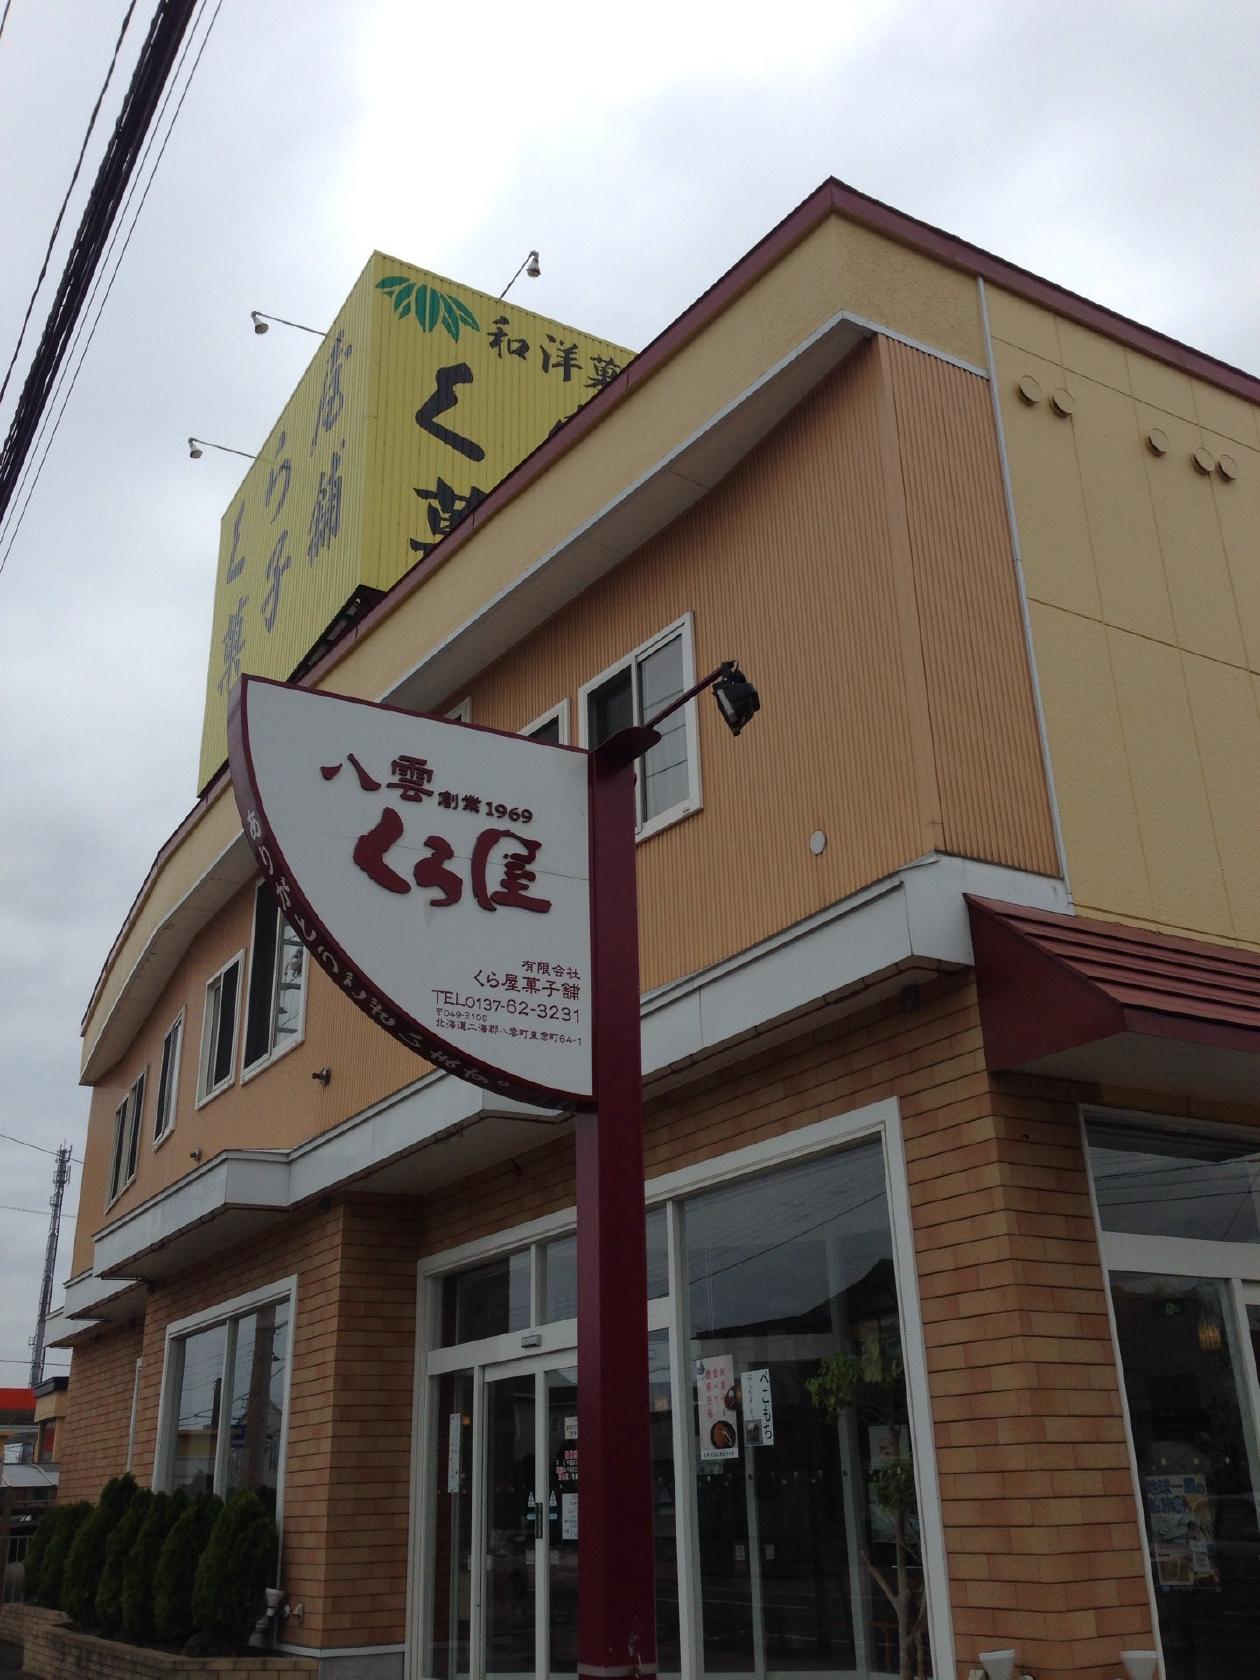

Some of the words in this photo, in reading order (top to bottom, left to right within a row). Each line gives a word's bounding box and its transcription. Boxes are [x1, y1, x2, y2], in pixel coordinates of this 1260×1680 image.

[320, 753, 434, 803] 八雲
[438, 790, 533, 824] 創業1969
[353, 807, 552, 913] くら屋
[473, 969, 581, 1001] くら屋菓子舗
[521, 960, 580, 980] 有限会社
